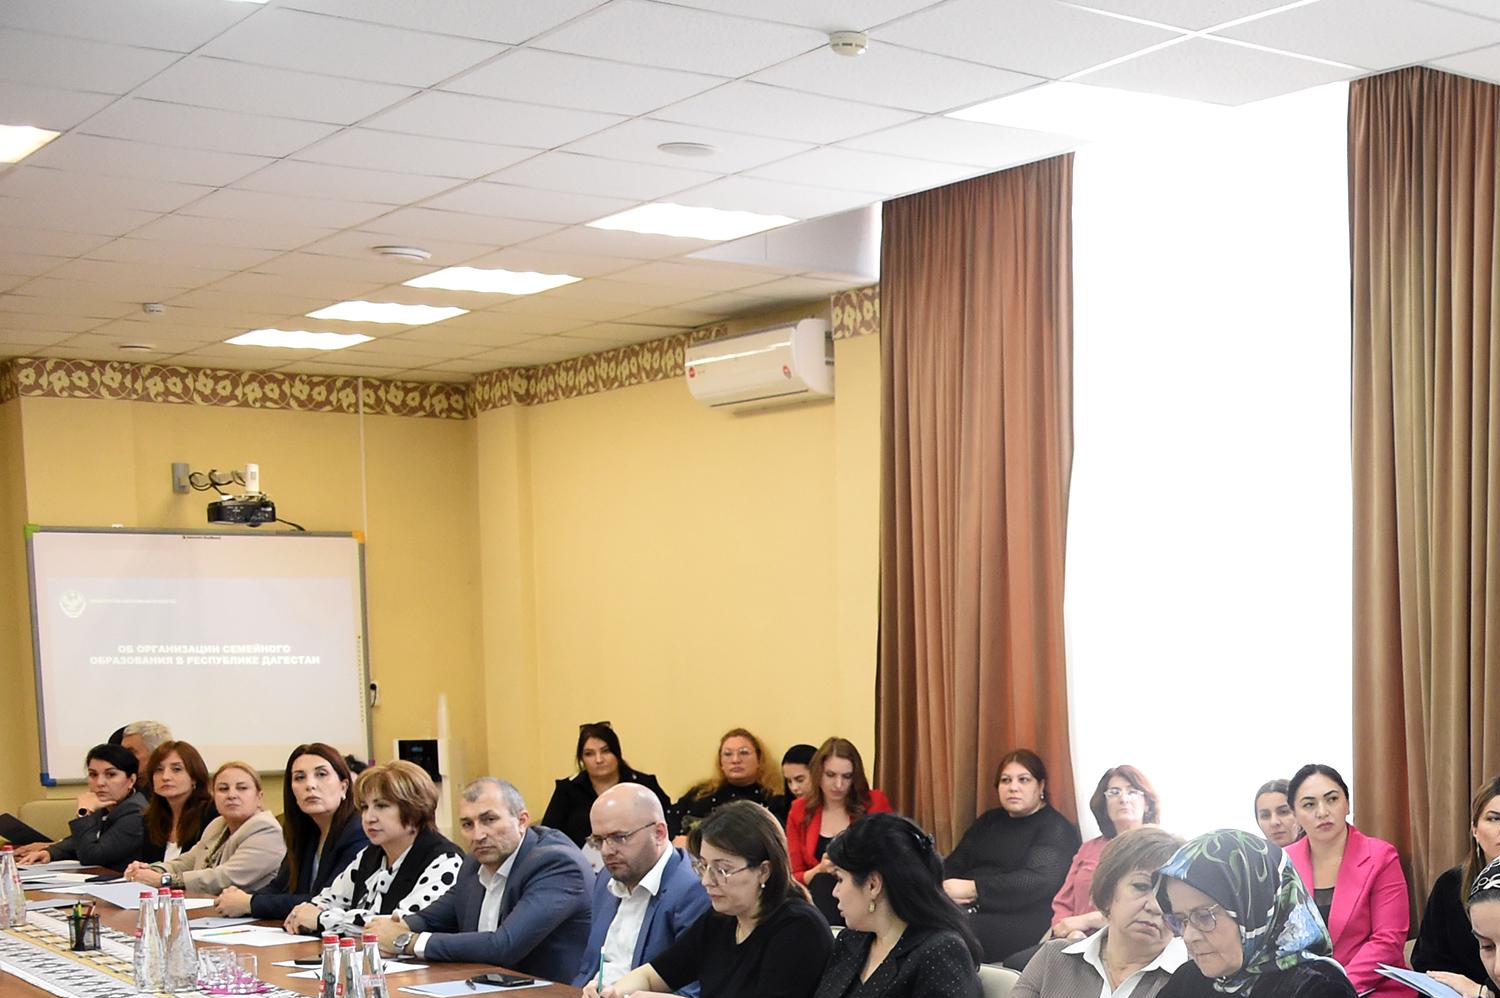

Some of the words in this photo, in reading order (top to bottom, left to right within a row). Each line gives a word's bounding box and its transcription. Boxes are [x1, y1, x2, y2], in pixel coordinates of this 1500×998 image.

[117, 645, 134, 654] ОБ
[136, 645, 220, 655] ОРГАНИЗАЦИИ
[222, 643, 292, 654] СЕМЕЙНОГО
[89, 656, 173, 665] ОБРАЗОВАНИЯ
[176, 656, 184, 665] В
[186, 656, 259, 665] РЕСПУБЛИКЕ
[261, 656, 320, 666] ДАГЕСТАН
